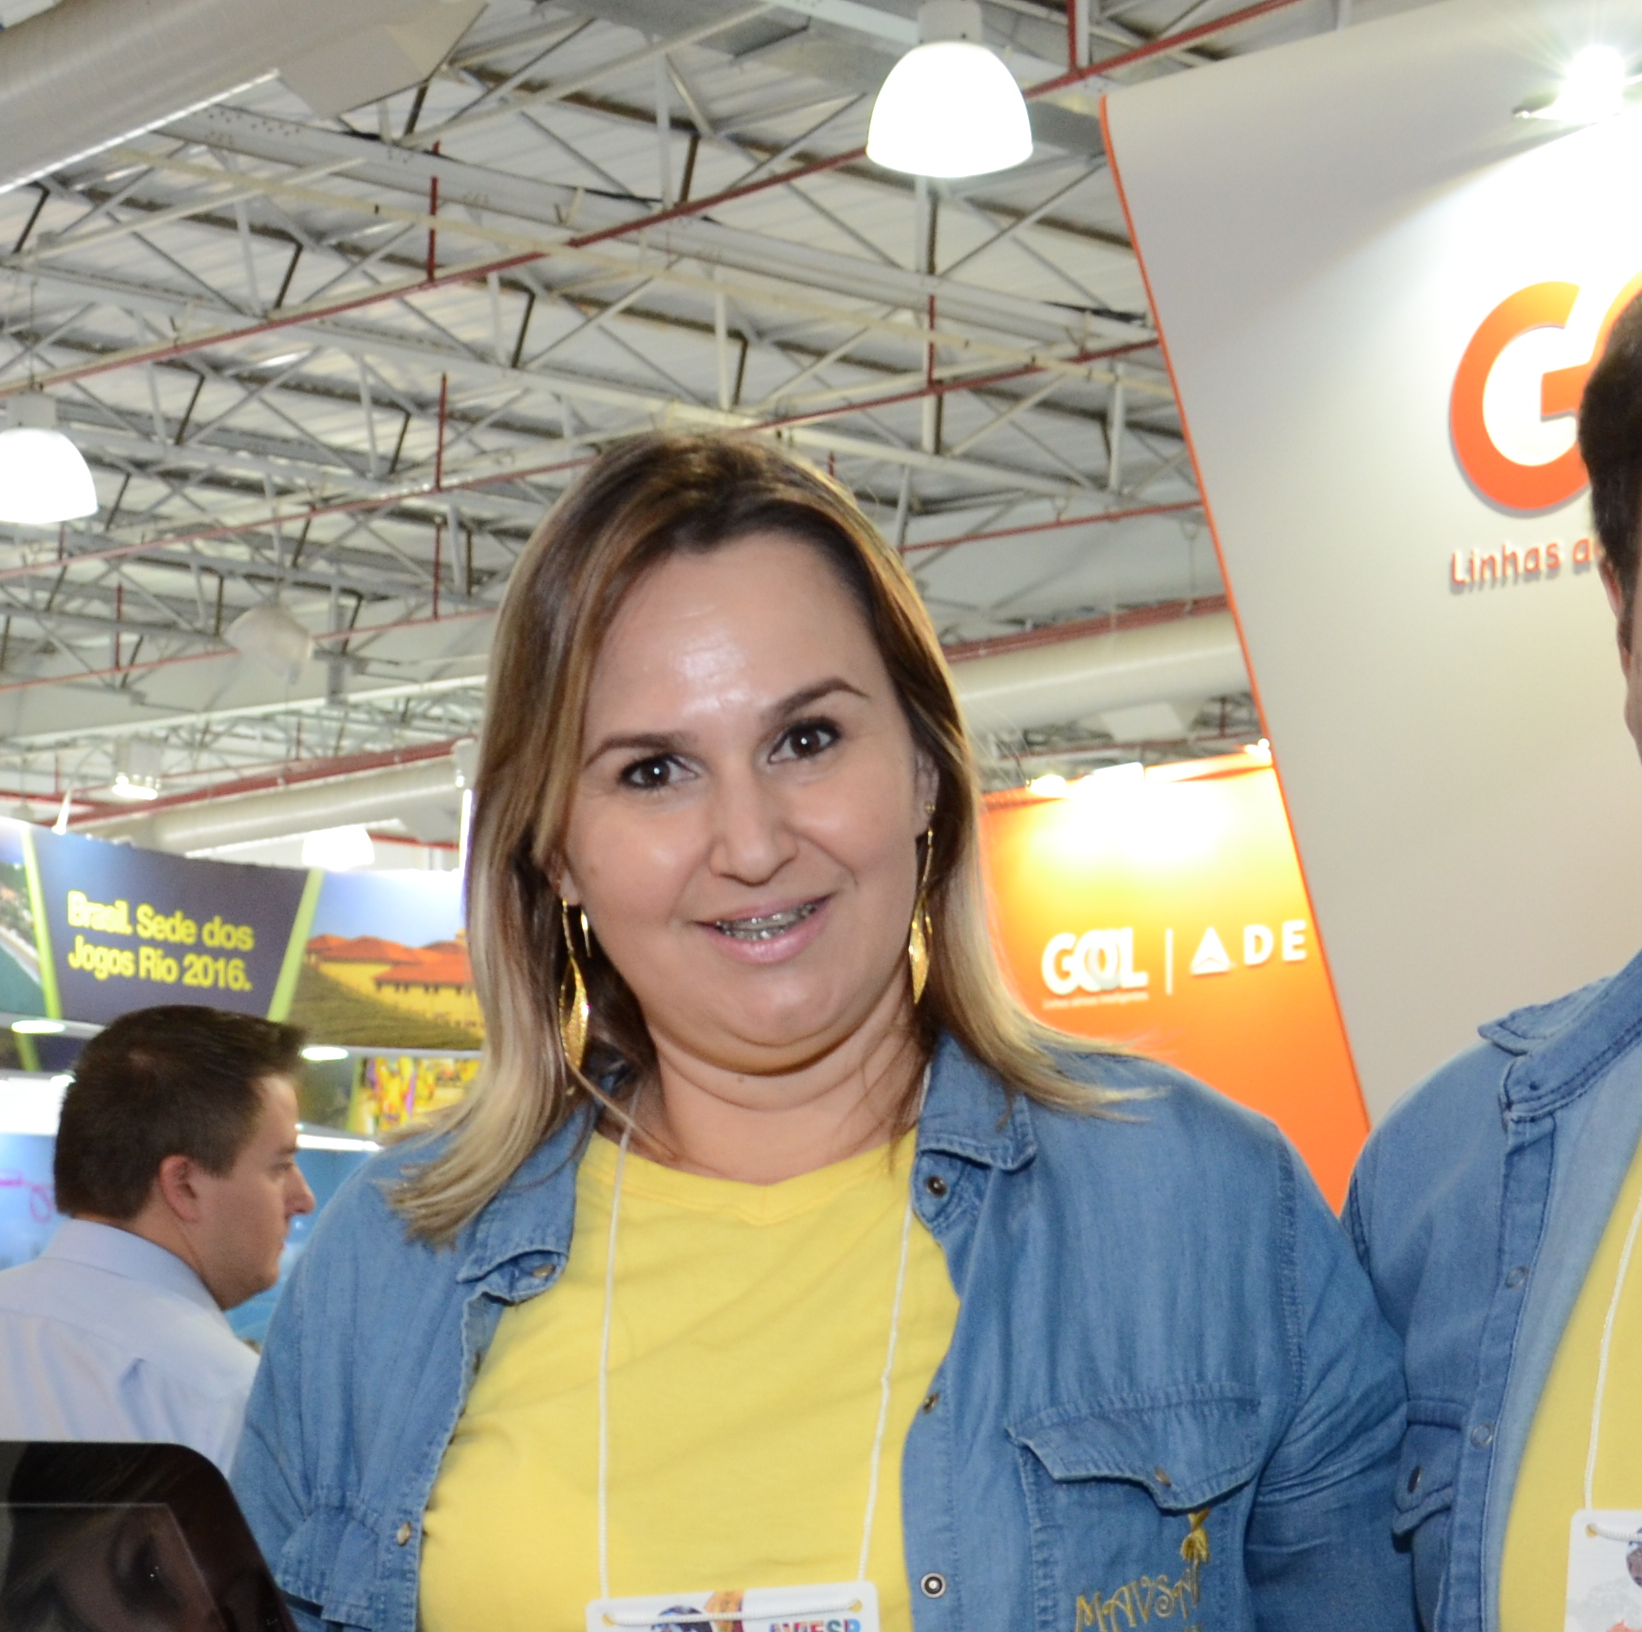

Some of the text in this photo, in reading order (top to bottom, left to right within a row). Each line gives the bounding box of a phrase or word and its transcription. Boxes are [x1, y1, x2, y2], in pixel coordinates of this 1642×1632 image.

[1450, 543, 1561, 588] Linhas
[67, 889, 254, 951] Brasil. Sede dos
[68, 934, 252, 992] Jogos Rio 2016.
[1042, 919, 1307, 996] GOL DE
